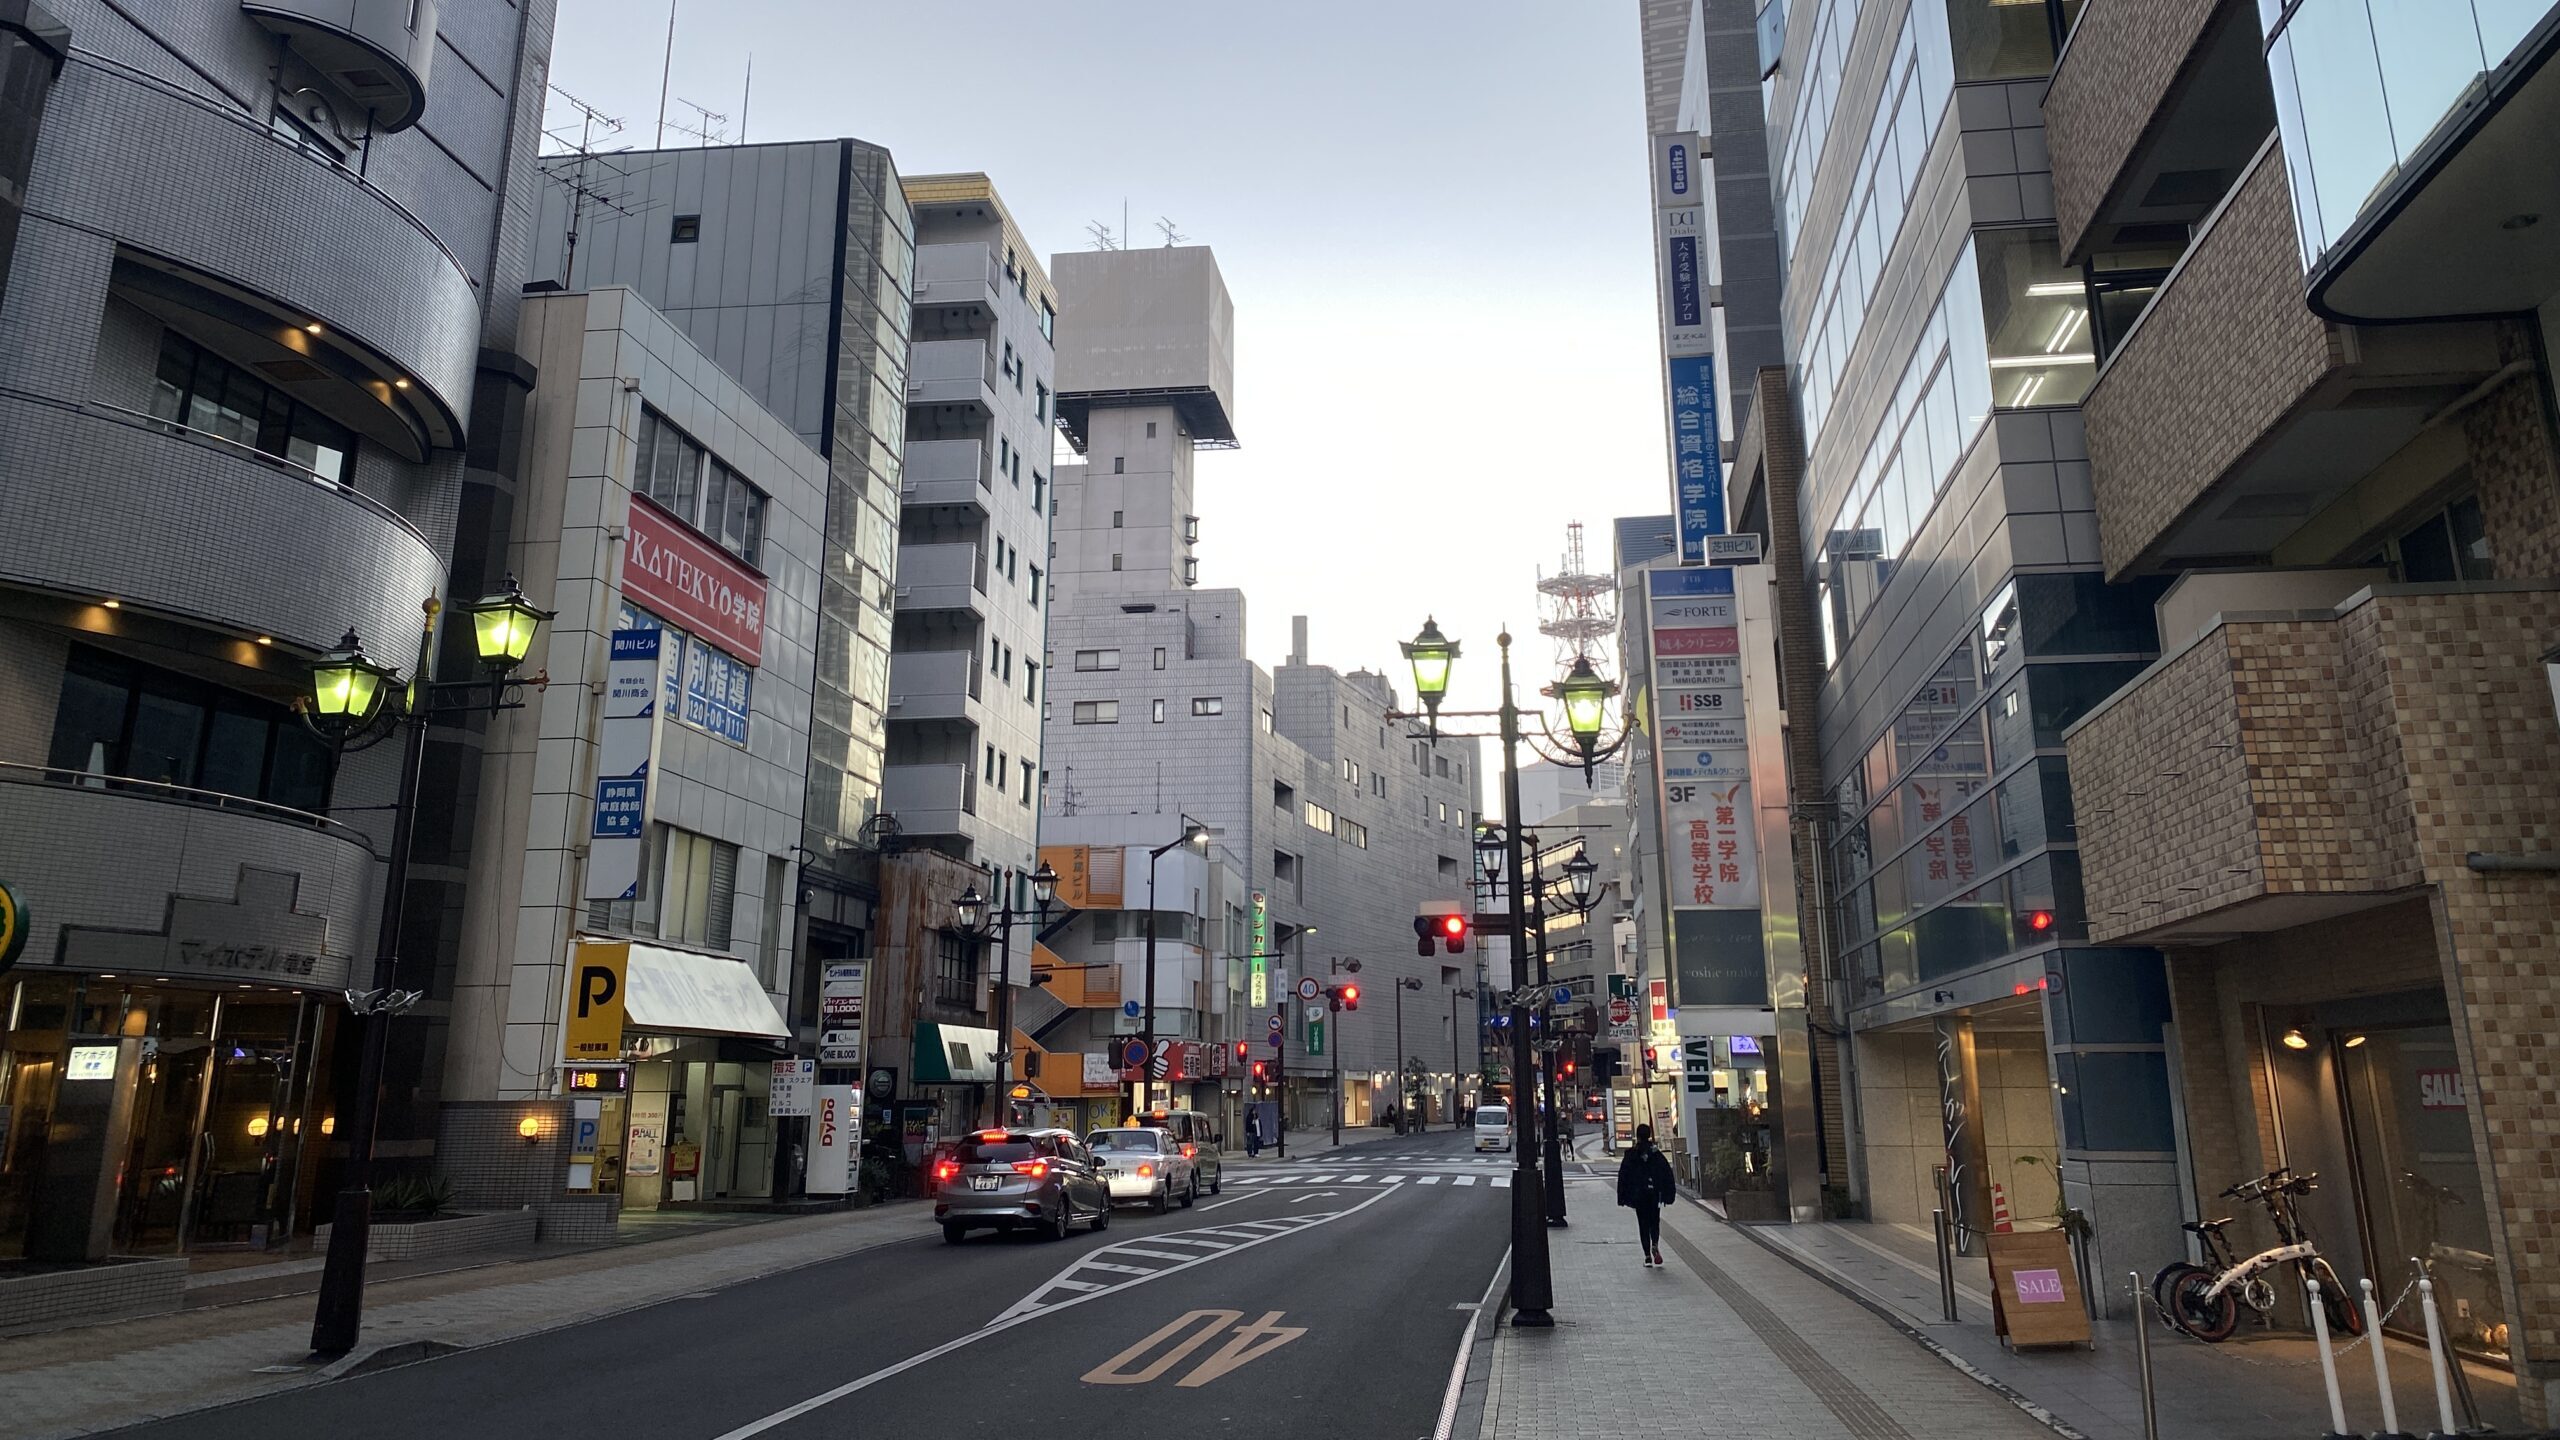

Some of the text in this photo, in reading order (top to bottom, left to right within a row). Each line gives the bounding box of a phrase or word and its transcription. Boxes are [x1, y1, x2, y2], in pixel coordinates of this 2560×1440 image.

[1672, 149, 1685, 190] Berlitz
[1669, 227, 1696, 236] Dialo
[1678, 241, 1692, 321] 大学受験ディアロ
[1677, 386, 1708, 530] 総合資格学院
[1711, 539, 1755, 554] 芝田ビル
[630, 529, 761, 635] KATEKYO学院
[1684, 606, 1727, 617] FORTE
[614, 639, 657, 651] 関川ビル
[619, 677, 645, 685] 有限会社
[1672, 676, 1726, 684] IMMIGRATION
[612, 688, 649, 698] 関川商会
[1694, 694, 1722, 707] SSB
[605, 787, 636, 798] 静岡県
[1669, 786, 1696, 803] 3F
[599, 801, 640, 812] 家庭教師
[1715, 805, 1740, 883] 第一学院
[1689, 819, 1714, 904] 高等学校
[1253, 905, 1264, 973] フジカラー
[577, 965, 617, 1018] P
[1302, 983, 1315, 995] 40
[823, 1050, 856, 1059] ONE BLOOD
[773, 1061, 811, 1074] 指定 P
[2420, 1072, 2466, 1106] SALE
[1089, 1103, 1109, 1119] OK
[822, 1098, 836, 1147] DyDo
[579, 1121, 595, 1144] P
[2018, 1278, 2061, 1295] SALE
[1079, 1308, 1309, 1388] 40
